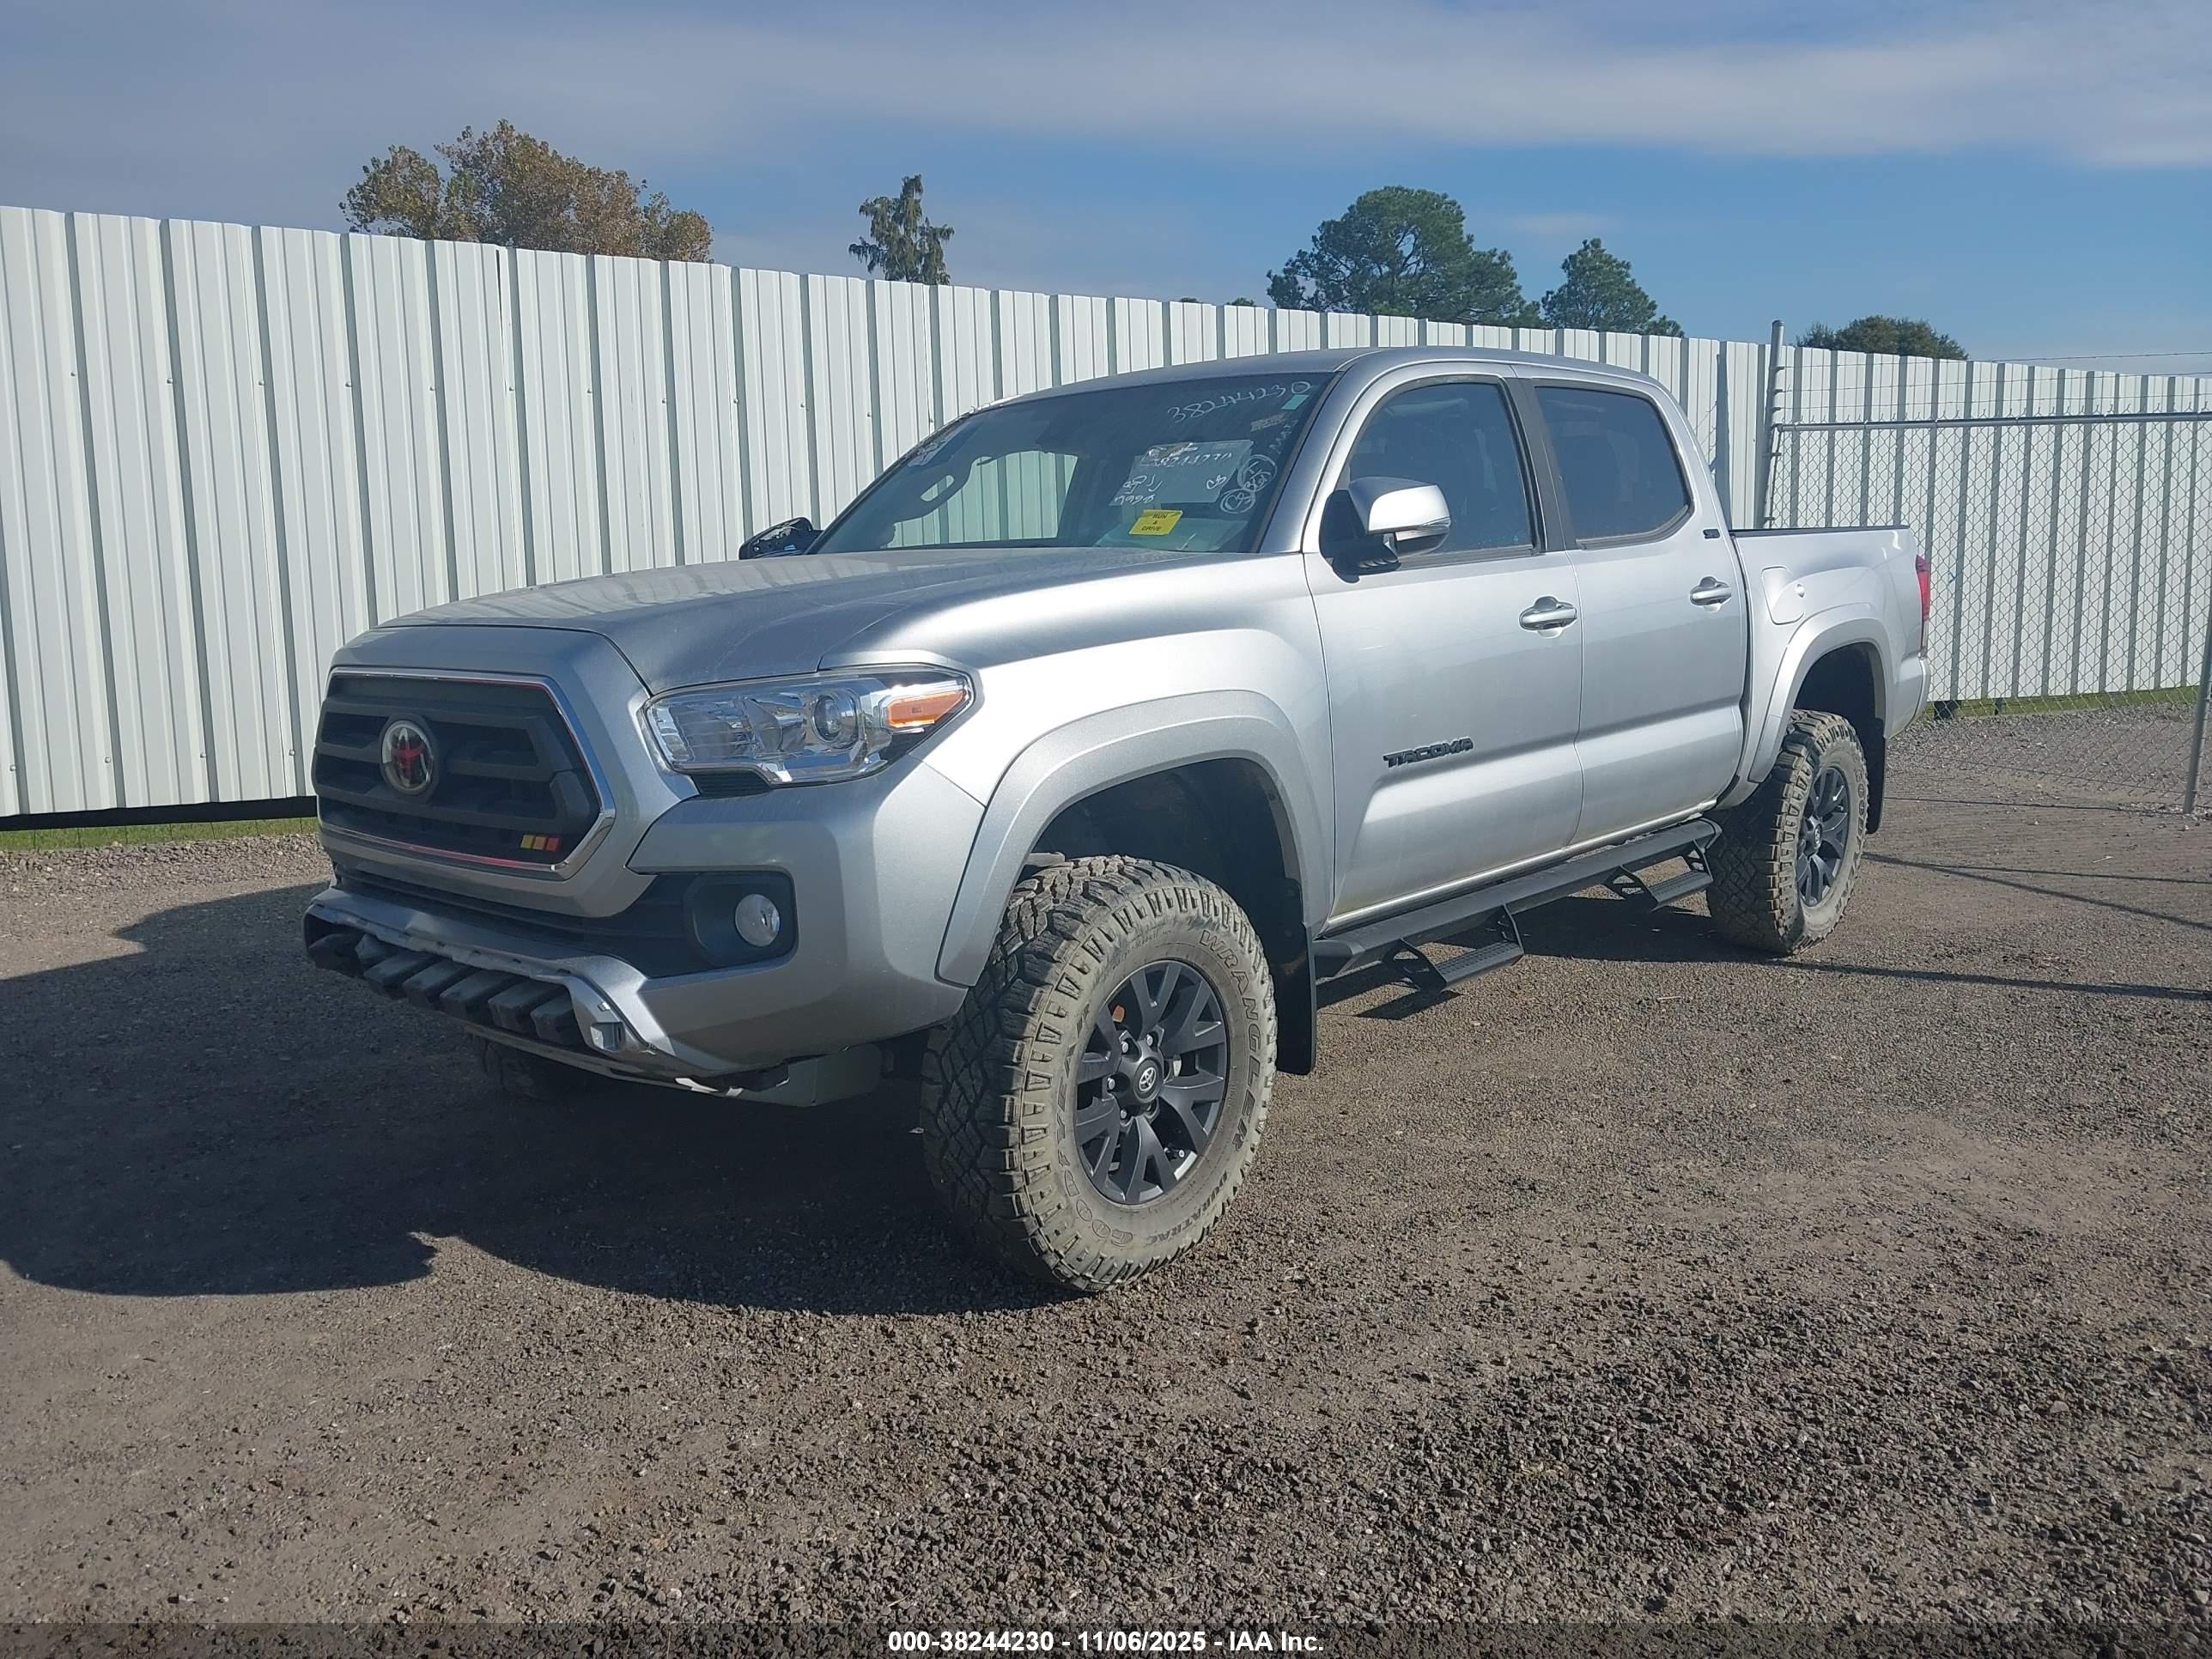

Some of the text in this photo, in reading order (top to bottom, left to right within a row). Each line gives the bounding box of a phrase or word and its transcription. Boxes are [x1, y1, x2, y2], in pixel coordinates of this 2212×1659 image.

[1168, 380, 1311, 423] 38244230
[1382, 738, 1474, 769] TACOMA
[1200, 930, 1261, 1152] WRANGLER
